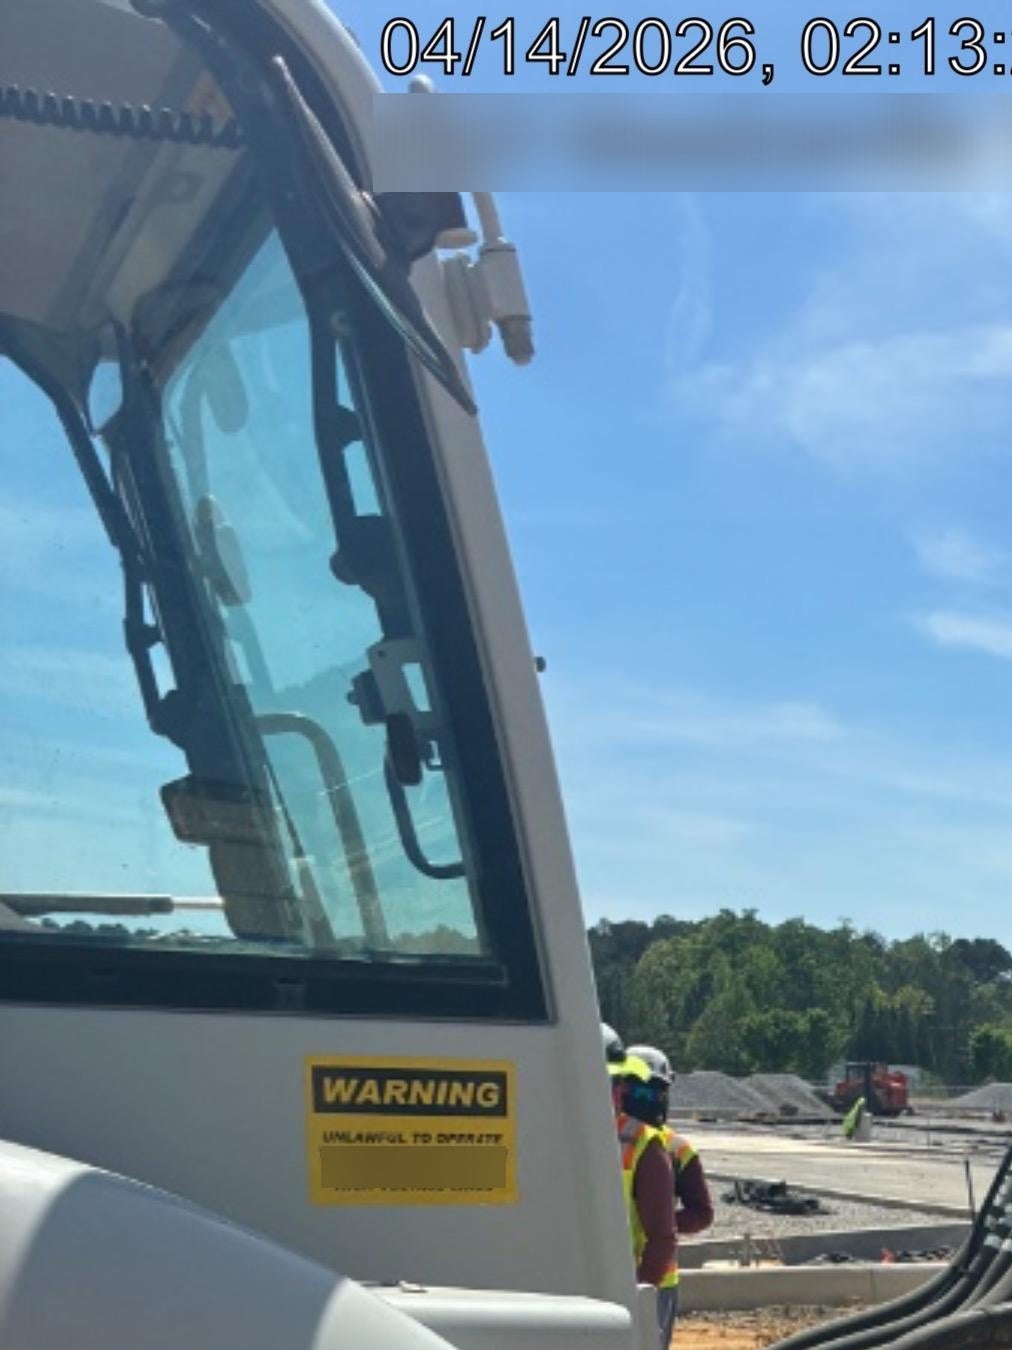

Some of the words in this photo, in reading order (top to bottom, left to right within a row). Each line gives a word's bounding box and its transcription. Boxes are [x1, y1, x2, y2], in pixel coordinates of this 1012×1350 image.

[323, 1077, 499, 1107] WARNING
[322, 1131, 407, 1144] UNLAWFUL
[412, 1132, 433, 1144] TO
[437, 1133, 503, 1145] OPERATE
